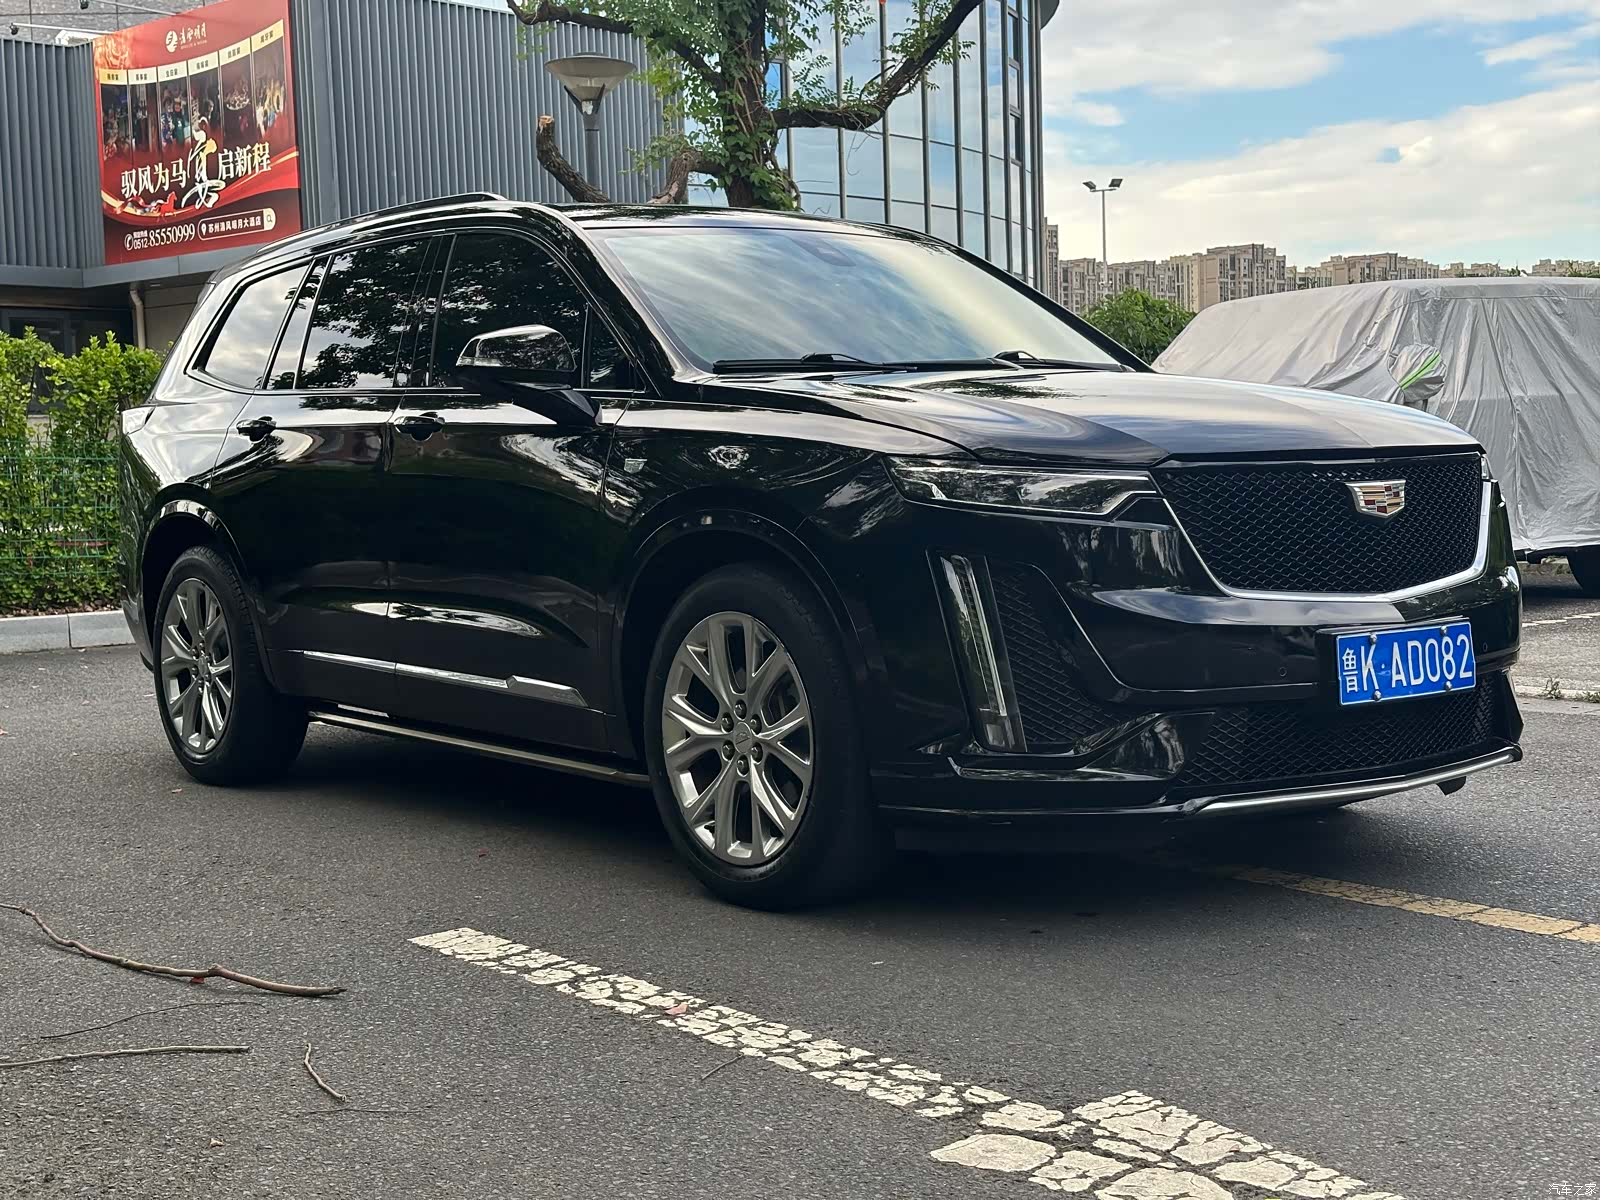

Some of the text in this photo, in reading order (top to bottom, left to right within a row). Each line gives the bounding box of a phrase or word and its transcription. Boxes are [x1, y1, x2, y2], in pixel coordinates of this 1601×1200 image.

[121, 158, 187, 198] 驭风为马
[218, 141, 271, 180] 启新程
[208, 215, 261, 233] 苏州清风明月大酒店
